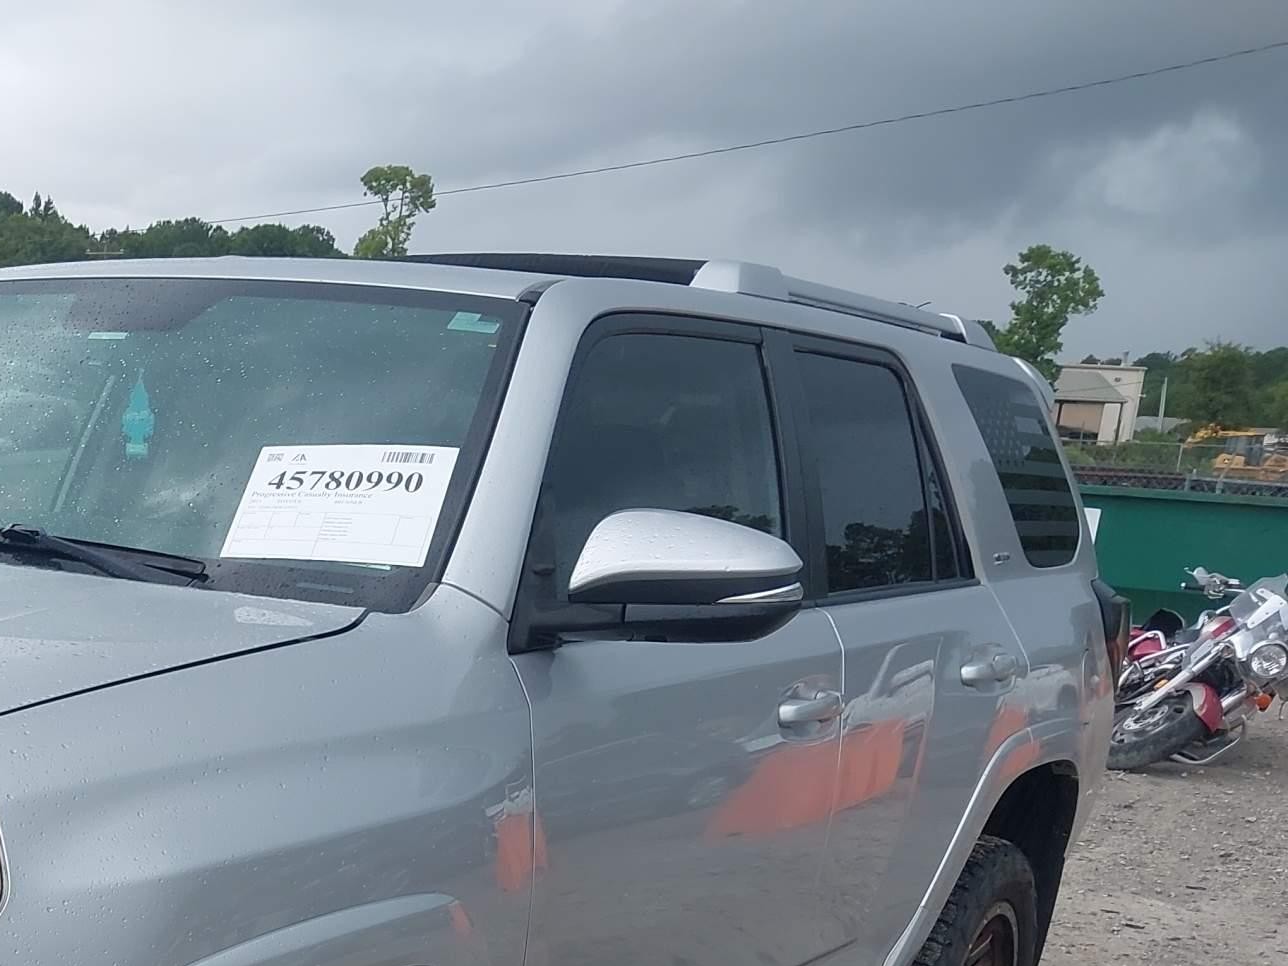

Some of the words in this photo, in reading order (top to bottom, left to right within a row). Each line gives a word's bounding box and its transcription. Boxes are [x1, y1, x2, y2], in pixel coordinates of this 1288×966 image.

[267, 470, 424, 493] 45780990
[298, 491, 331, 499] Casualty
[334, 491, 373, 499] Insurance
